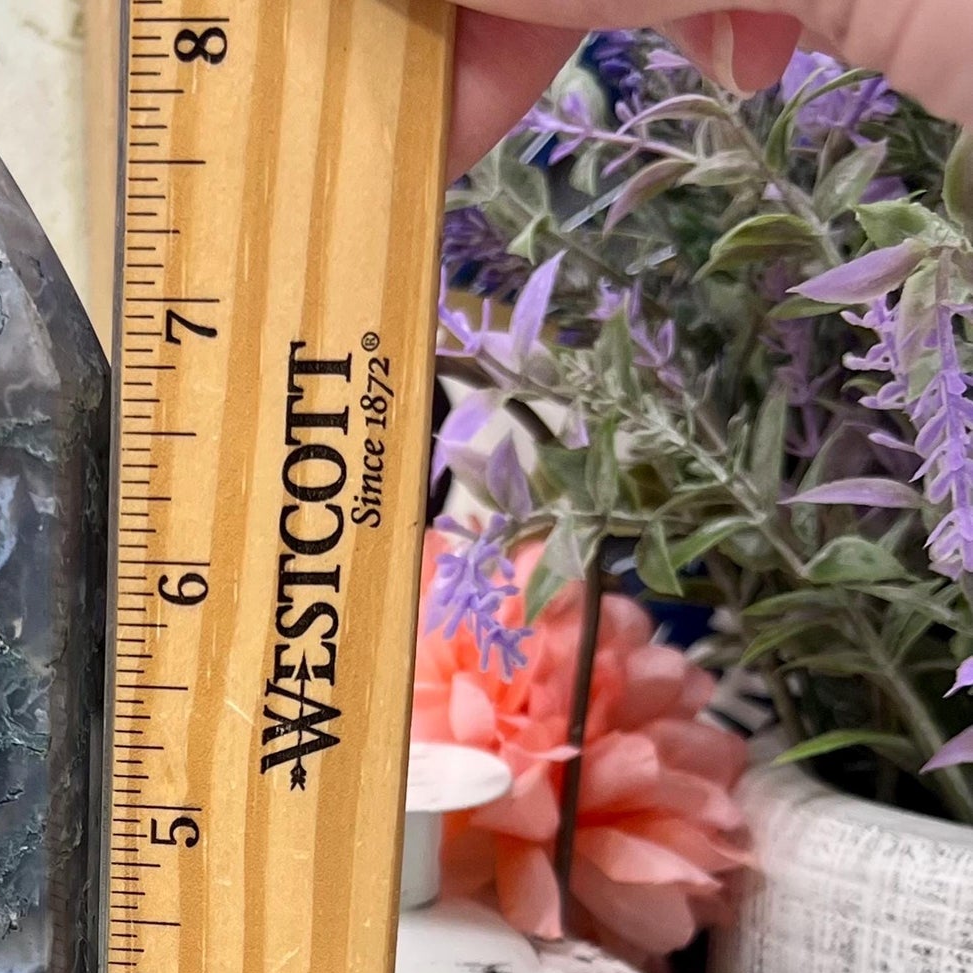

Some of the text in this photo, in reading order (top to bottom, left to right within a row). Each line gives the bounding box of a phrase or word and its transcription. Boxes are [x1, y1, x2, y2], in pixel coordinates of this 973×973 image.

[174, 27, 227, 64] 8
[165, 309, 218, 345] 7
[351, 437, 387, 528] Since
[260, 341, 353, 775] WESTCOTT
[158, 572, 209, 606] 6
[150, 816, 200, 848] 5
